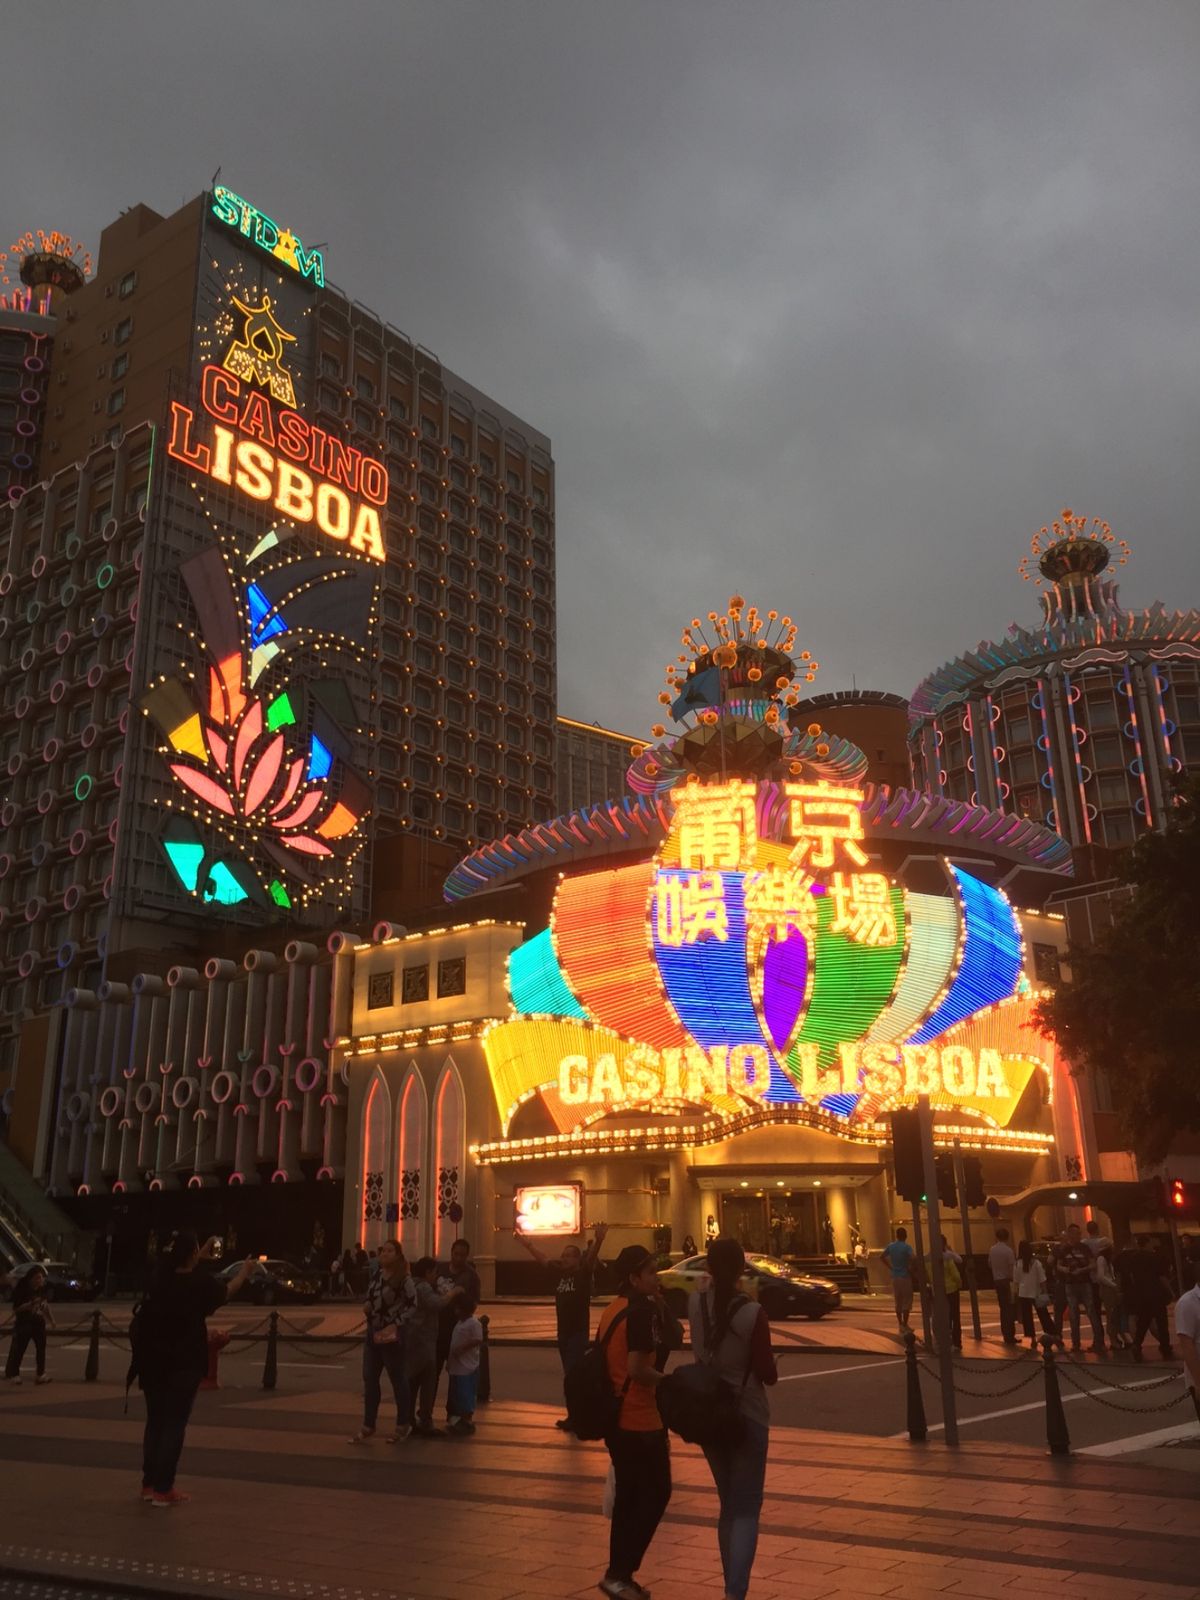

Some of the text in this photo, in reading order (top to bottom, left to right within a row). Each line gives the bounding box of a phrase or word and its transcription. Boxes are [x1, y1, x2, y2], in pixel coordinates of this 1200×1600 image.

[168, 401, 387, 562] LISBOA
[202, 364, 389, 506] CASINO
[670, 778, 869, 871] 葡京
[559, 1042, 1011, 1105] CASINO LISBOA
